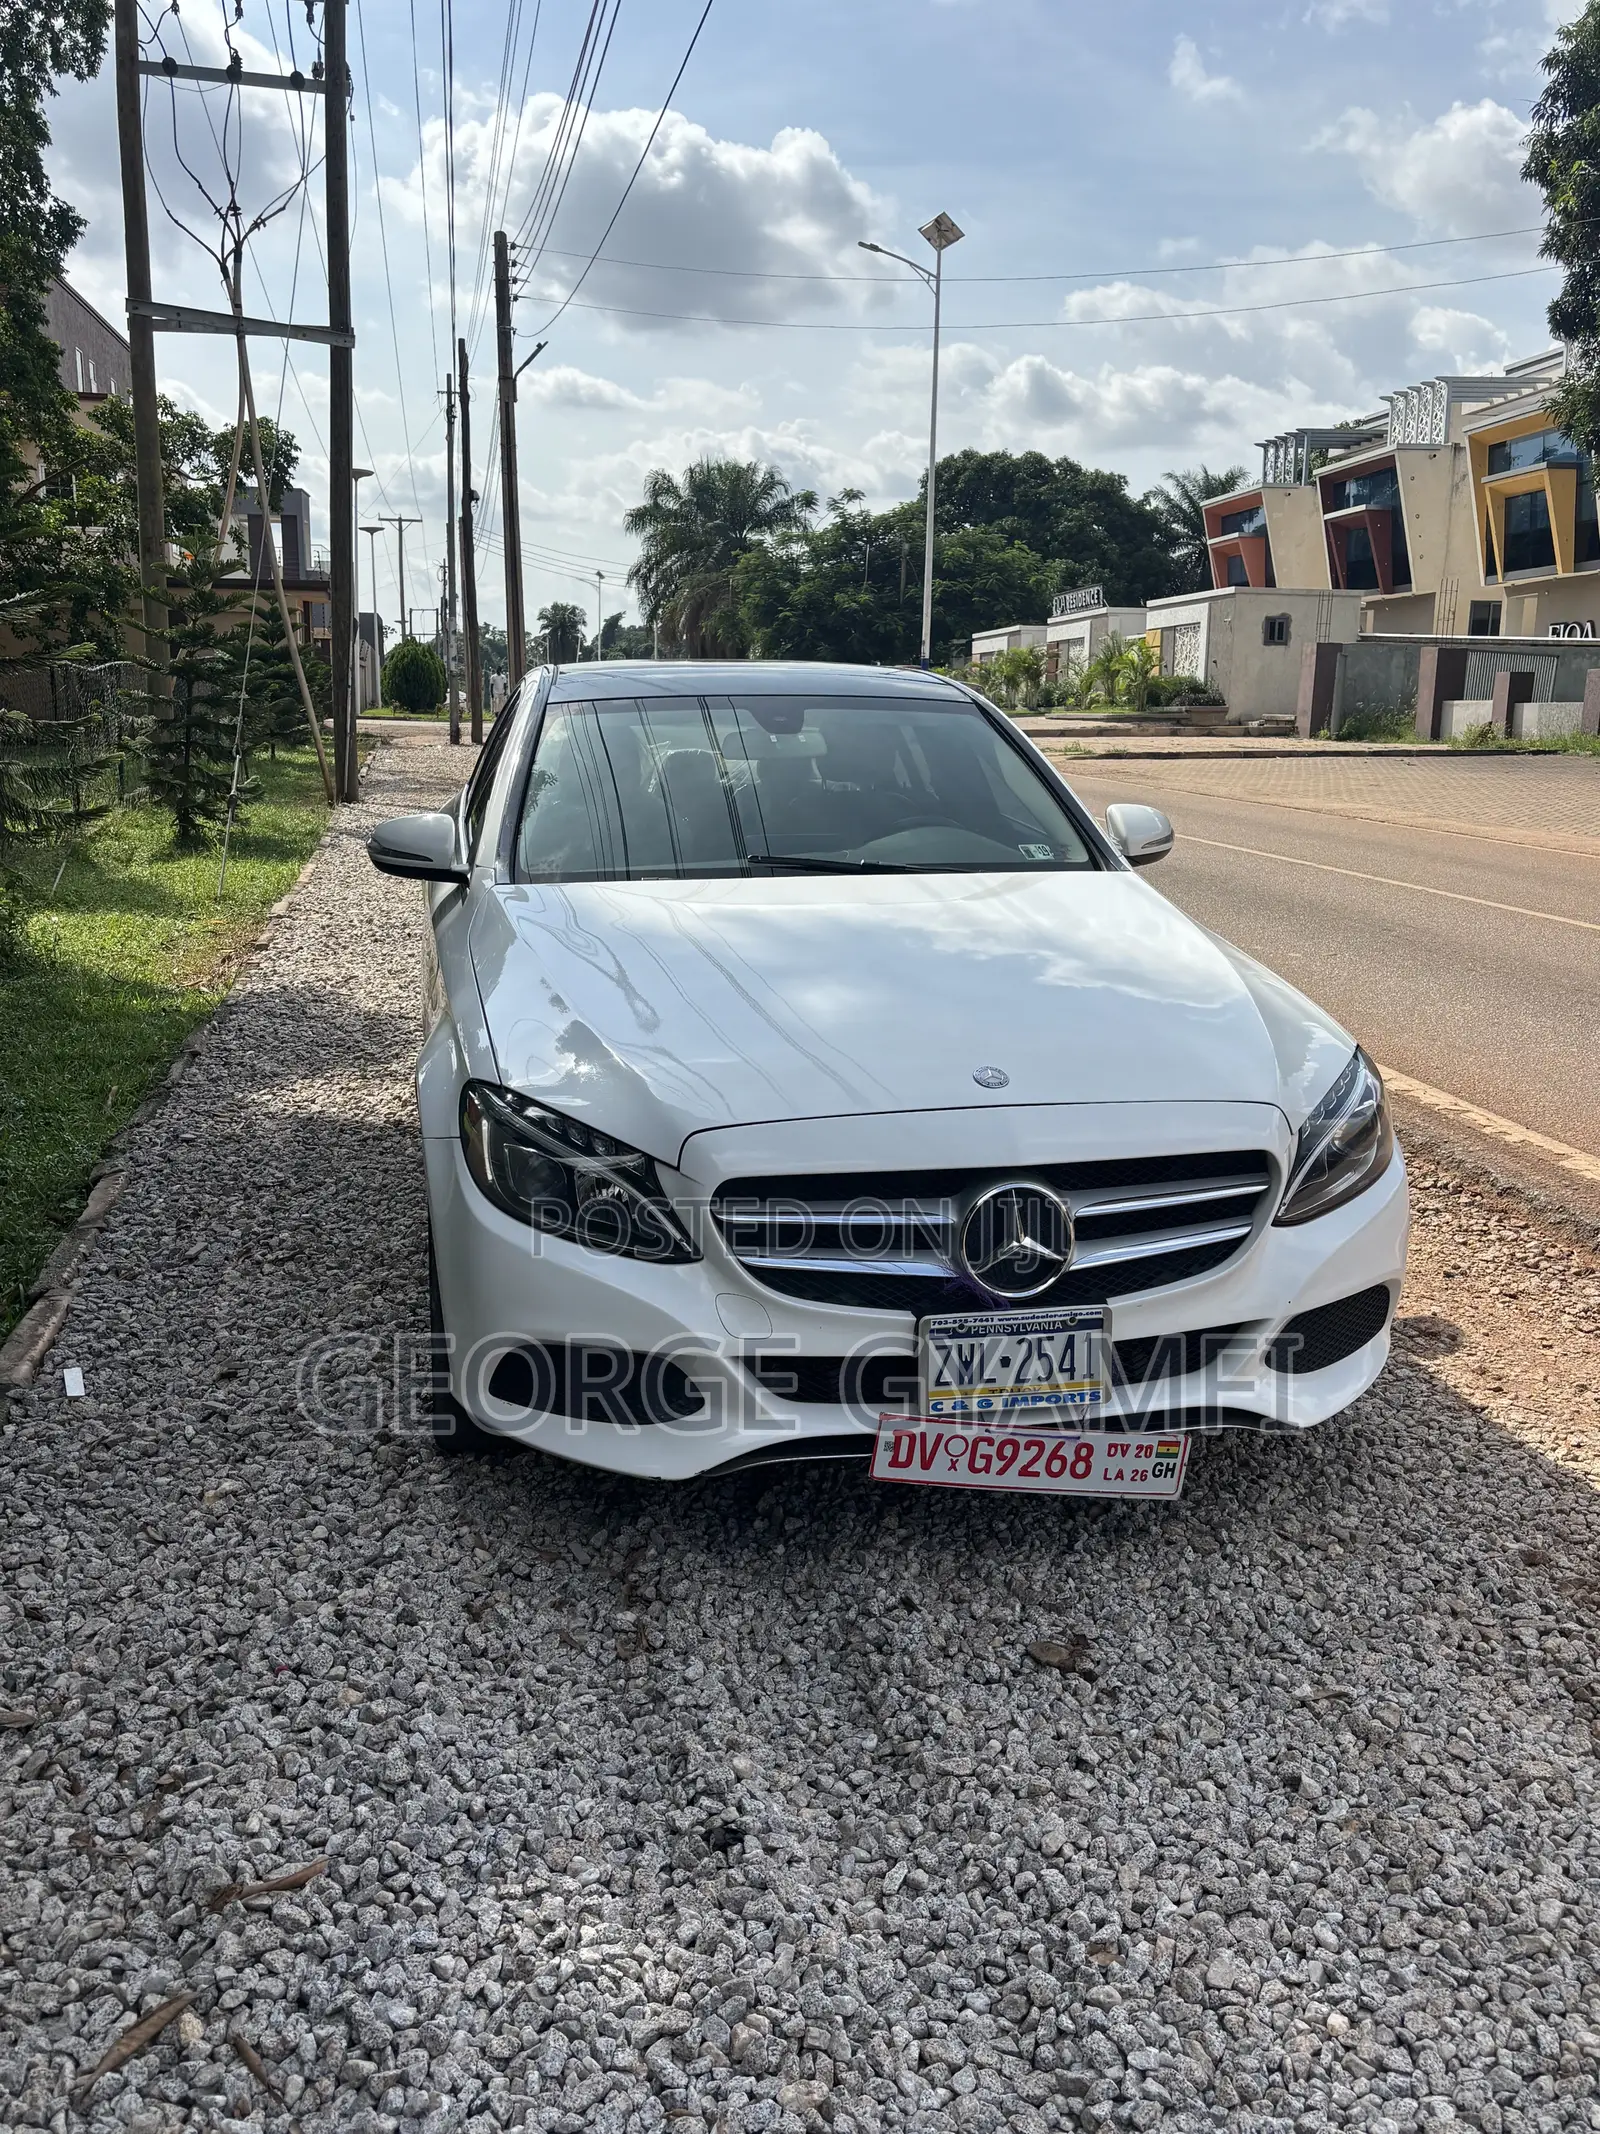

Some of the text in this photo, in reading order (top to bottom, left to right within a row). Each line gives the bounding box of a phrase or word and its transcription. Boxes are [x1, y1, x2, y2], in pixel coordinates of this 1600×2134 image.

[971, 1320, 1063, 1335] PENNSYLVANIA
[930, 1390, 1102, 1412] C & G IMPORTS
[1106, 1442, 1155, 1459] DV 20
[1103, 1467, 1149, 1482] LA 26
[1151, 1461, 1177, 1479] GH
